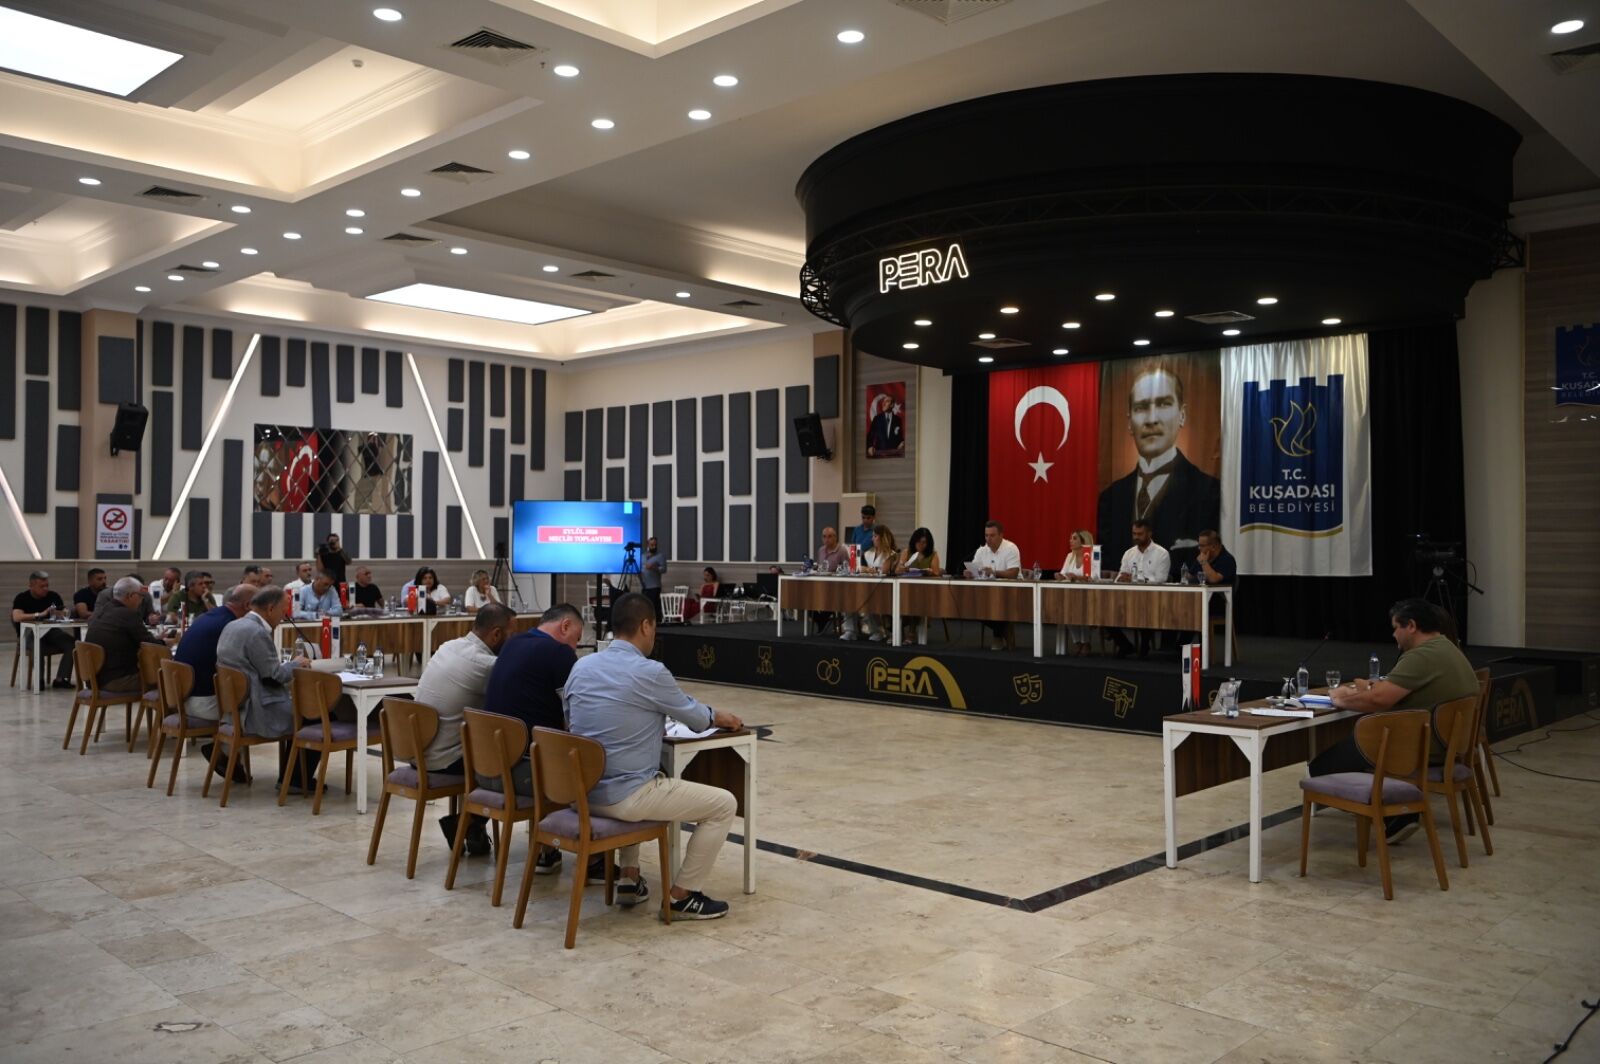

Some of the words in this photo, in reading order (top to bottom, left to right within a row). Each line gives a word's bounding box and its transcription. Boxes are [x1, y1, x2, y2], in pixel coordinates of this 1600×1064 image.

[879, 243, 970, 294] PERA
[1281, 468, 1307, 480] T.C.
[1249, 483, 1336, 500] KUŞADASI
[1249, 500, 1336, 513] BELEDİYESİ
[873, 666, 934, 695] PERA
